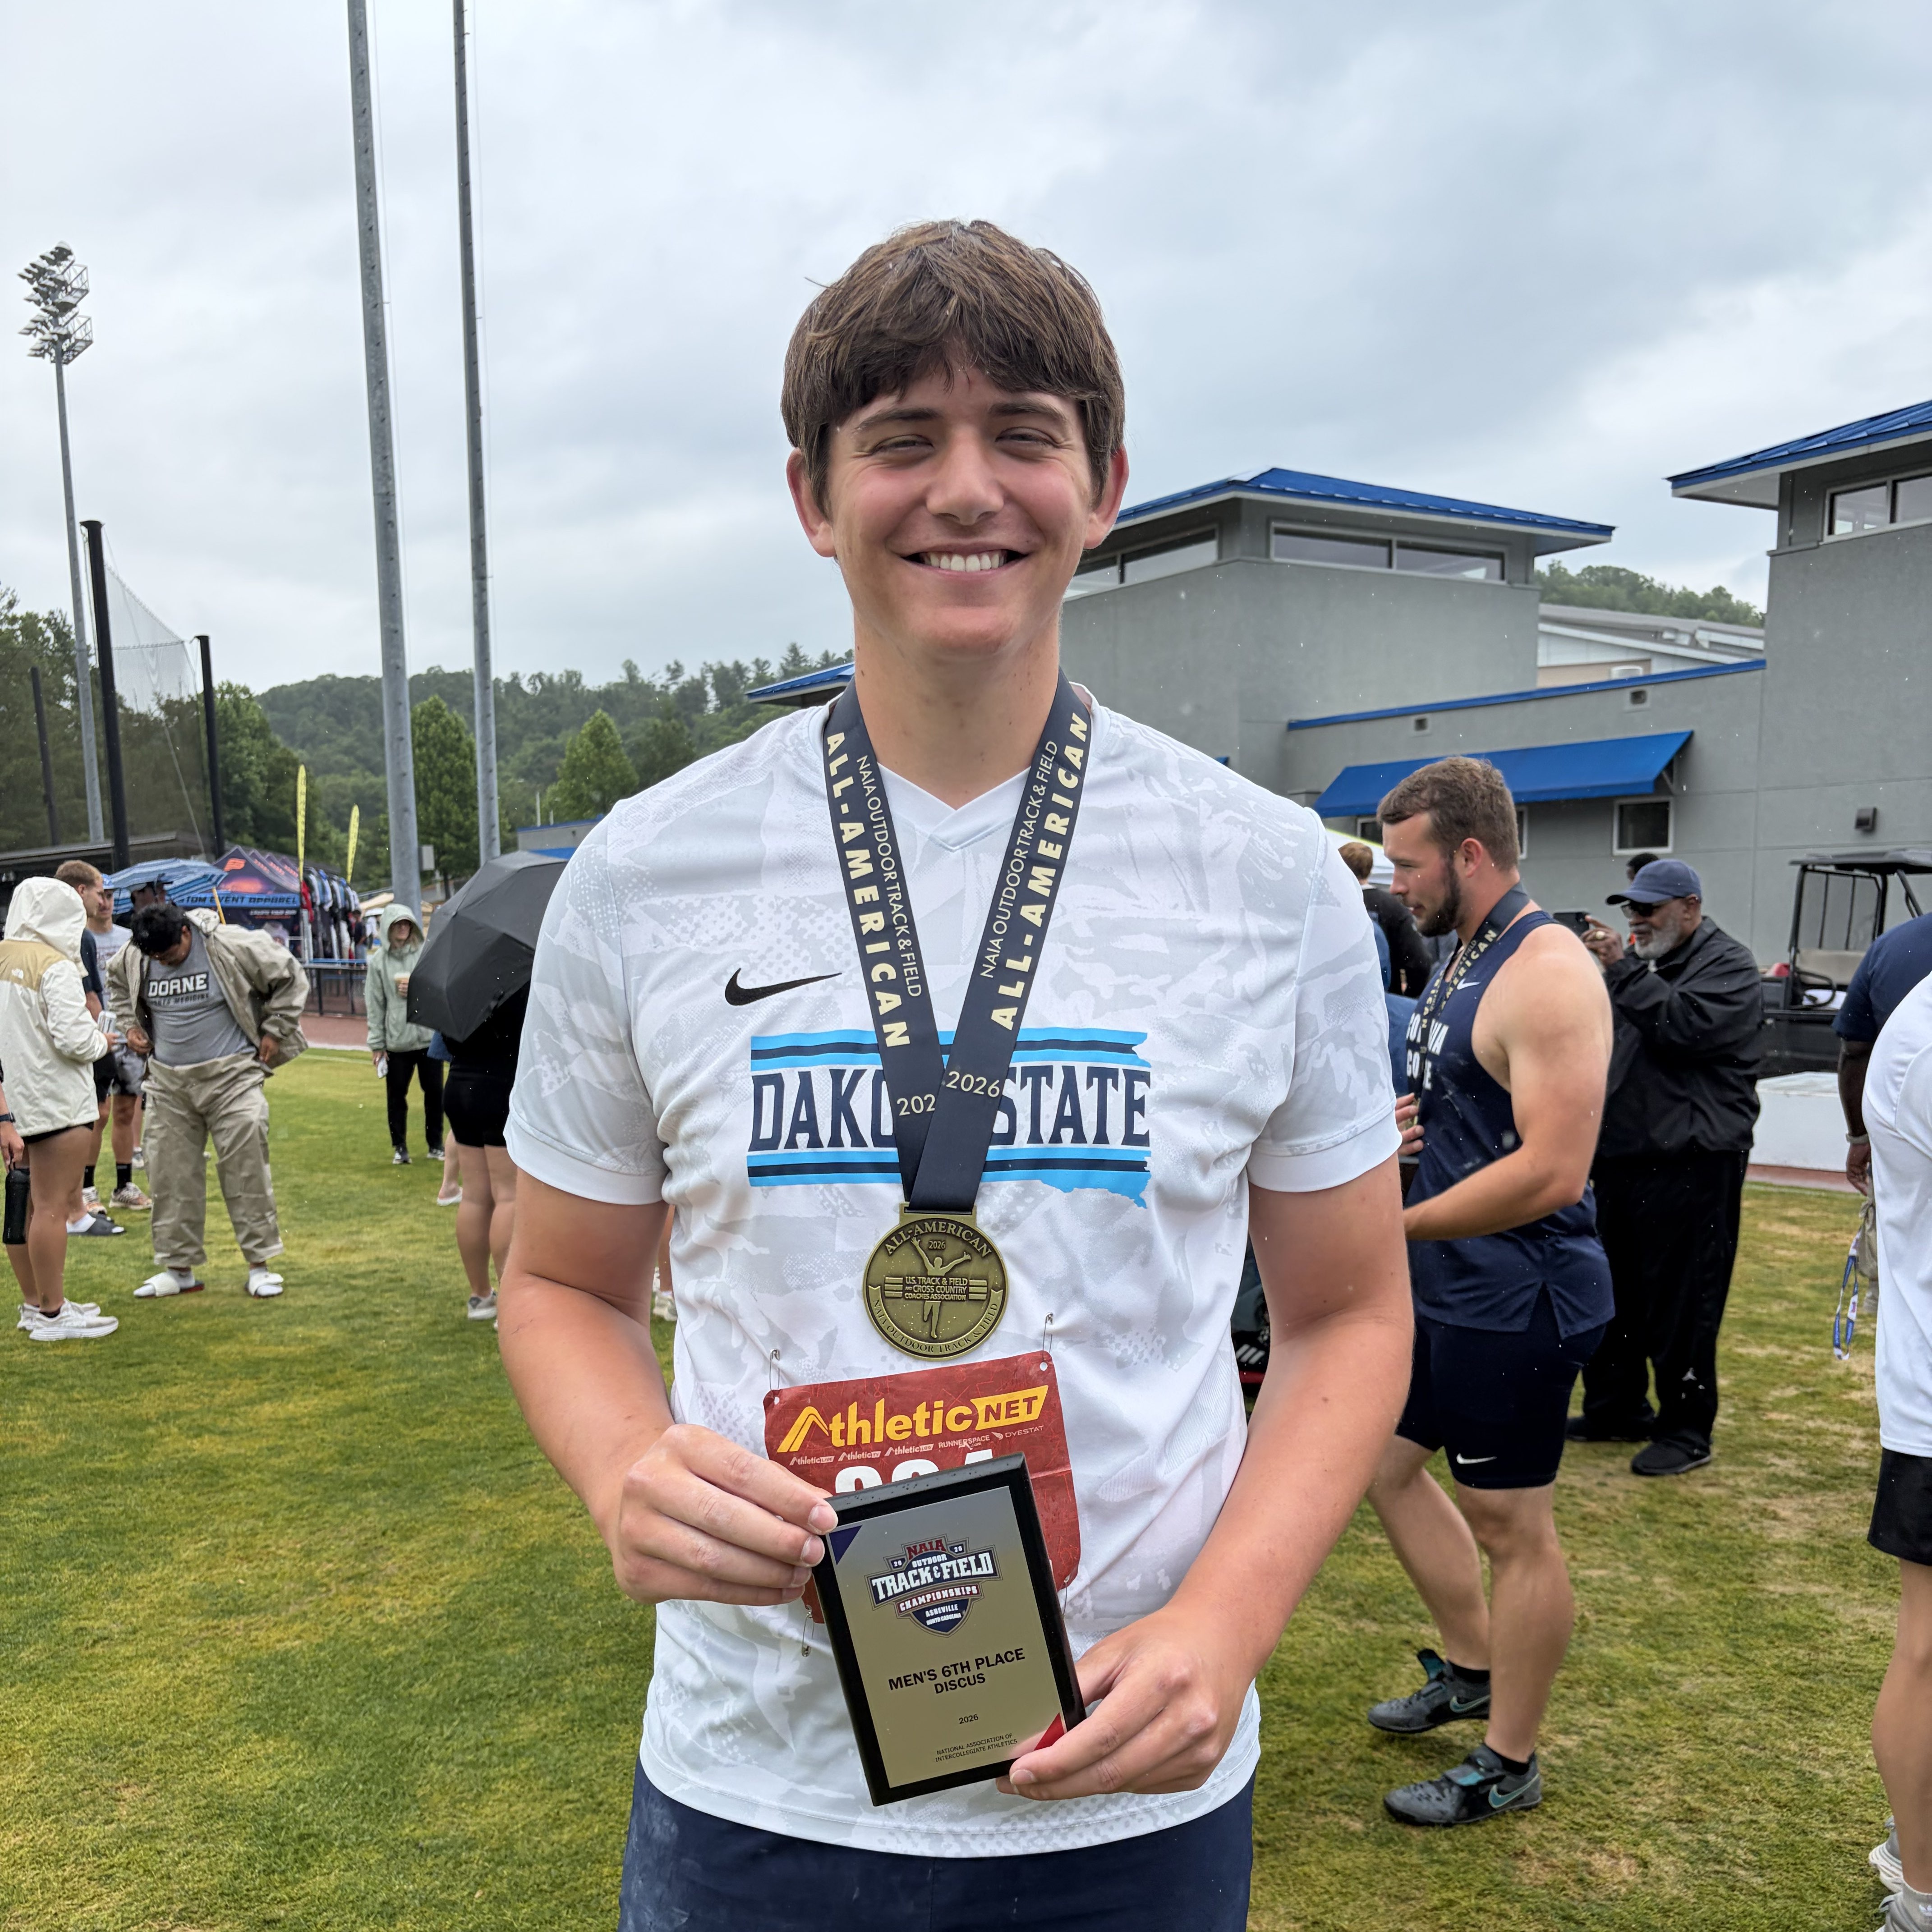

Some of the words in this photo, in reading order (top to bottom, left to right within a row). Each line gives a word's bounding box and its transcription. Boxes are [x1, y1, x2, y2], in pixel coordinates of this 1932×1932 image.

[857, 755, 877, 797] NAIA
[1036, 741, 1057, 783] FIELD
[1033, 785, 1046, 796] &
[1017, 795, 1043, 846] TRACK
[867, 797, 897, 882] OUTDOOR
[991, 712, 1087, 1030] ALL-AMERICAN
[827, 732, 910, 1047] ALL-AMERICAN
[993, 848, 1029, 934] OUTDOOR
[886, 882, 910, 936] TRACK
[898, 939, 912, 950] &
[980, 938, 1004, 978] NAIA
[148, 973, 208, 997] DOANE
[901, 952, 922, 997] FIELD
[946, 1071, 1000, 1097] 2026
[748, 1069, 897, 1152] DAKO
[989, 1065, 1150, 1147] STATE
[897, 1094, 935, 1116] 202
[884, 1221, 992, 1257] ALL-AMERICAN
[929, 1241, 945, 1249] 2026
[873, 1300, 887, 1325] NAIA
[887, 1326, 934, 1352] OUTDOOR
[938, 1338, 971, 1352] TRACK
[980, 1303, 998, 1330] FIELD
[906, 1539, 947, 1560] NAIA
[911, 1554, 947, 1568] OUTDOOR
[899, 1586, 978, 1611] CHAMPIONSHIPS
[925, 1604, 958, 1617] ASHEVILLE
[888, 1669, 937, 1690] MEN'S
[942, 1661, 971, 1677] 6TH
[975, 1648, 1025, 1670] PLACE
[934, 1673, 986, 1694] DISCUS
[959, 1714, 979, 1724] 2026
[935, 1746, 986, 1762] INTERCOLLEGIATE
[987, 1739, 1017, 1750] ATHLETICS
[937, 1744, 965, 1755] NATIONAL
[966, 1735, 1004, 1748] ASSOCIATION
